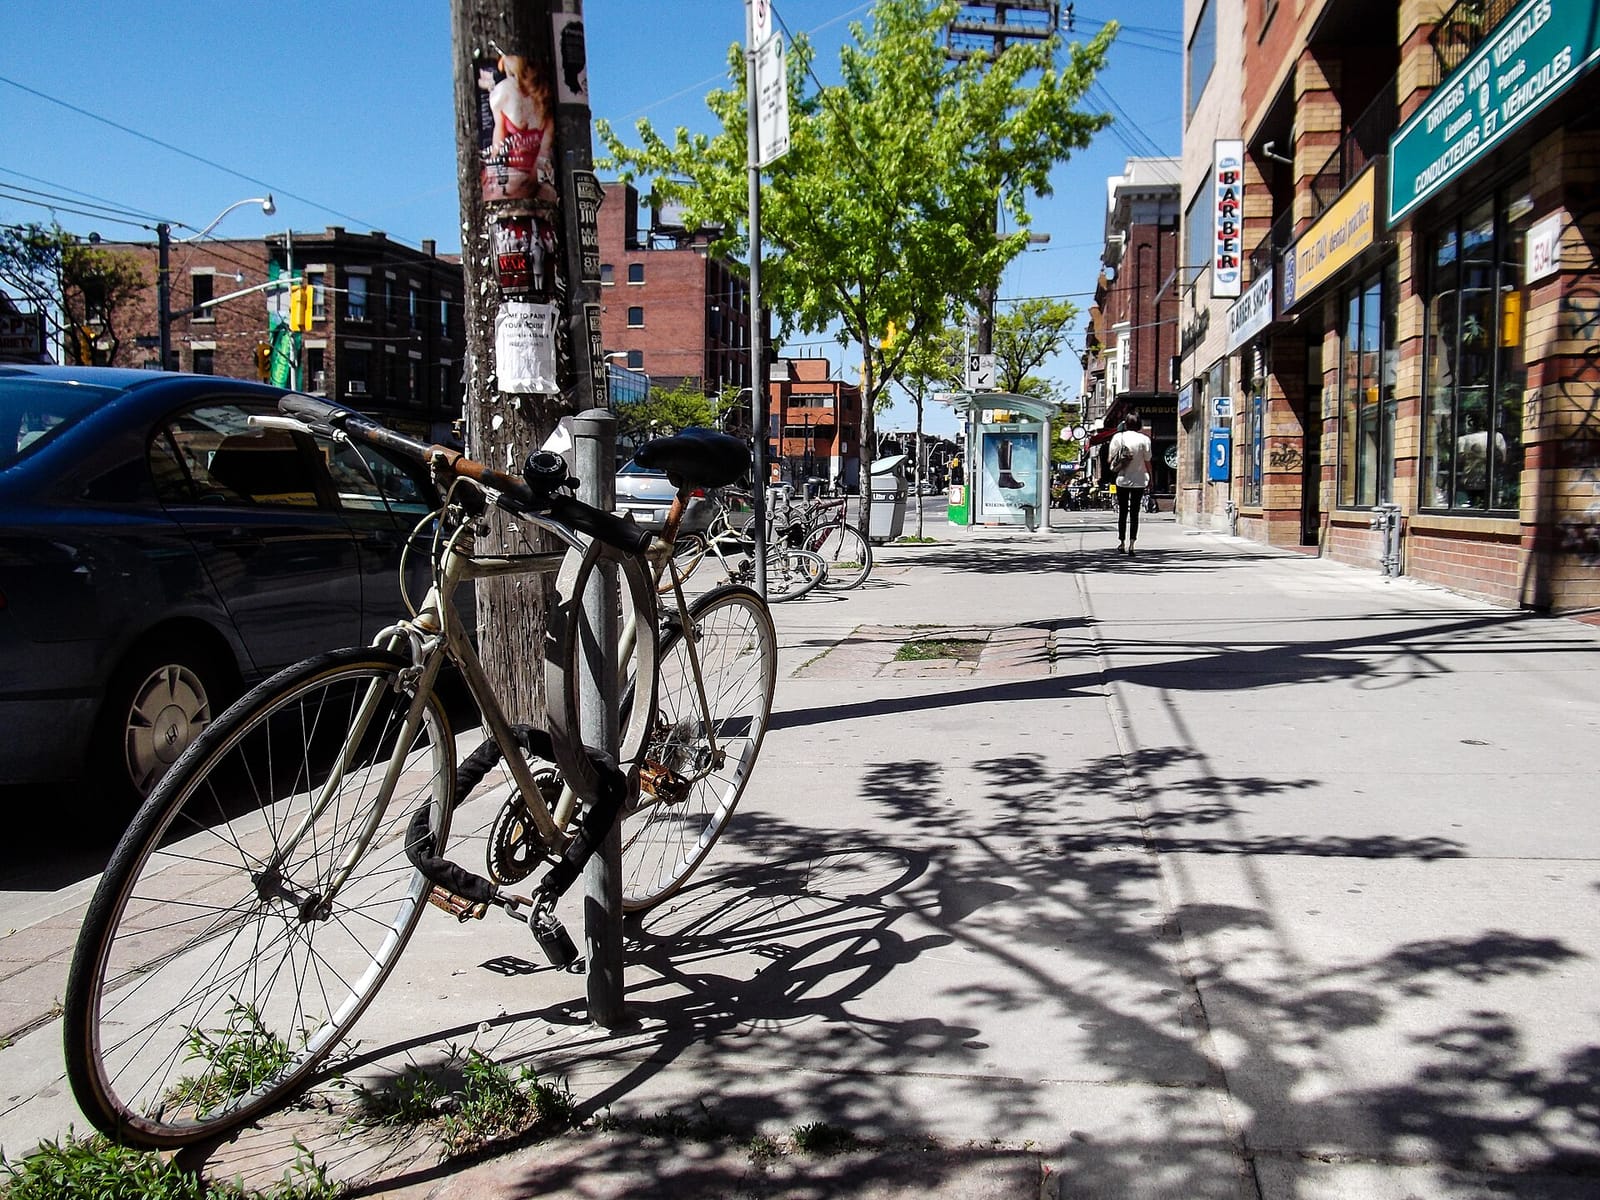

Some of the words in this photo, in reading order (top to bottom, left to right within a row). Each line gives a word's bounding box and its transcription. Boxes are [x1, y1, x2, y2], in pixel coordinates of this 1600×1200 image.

[1426, 82, 1465, 134] DRIVERS
[1468, 58, 1490, 95] AND
[1493, 0, 1552, 67] VEHICLES
[1498, 58, 1527, 93] Permis
[1414, 125, 1480, 194] CONDUCTEURS
[1483, 108, 1499, 139] ET
[1502, 45, 1572, 121] VÉHICULES
[1222, 171, 1235, 269] BARBER
[1347, 200, 1371, 246] practice
[500, 255, 526, 271] WAR
[1534, 240, 1550, 273] 534
[1231, 302, 1252, 333] BARBER
[1252, 282, 1270, 312] SHOP
